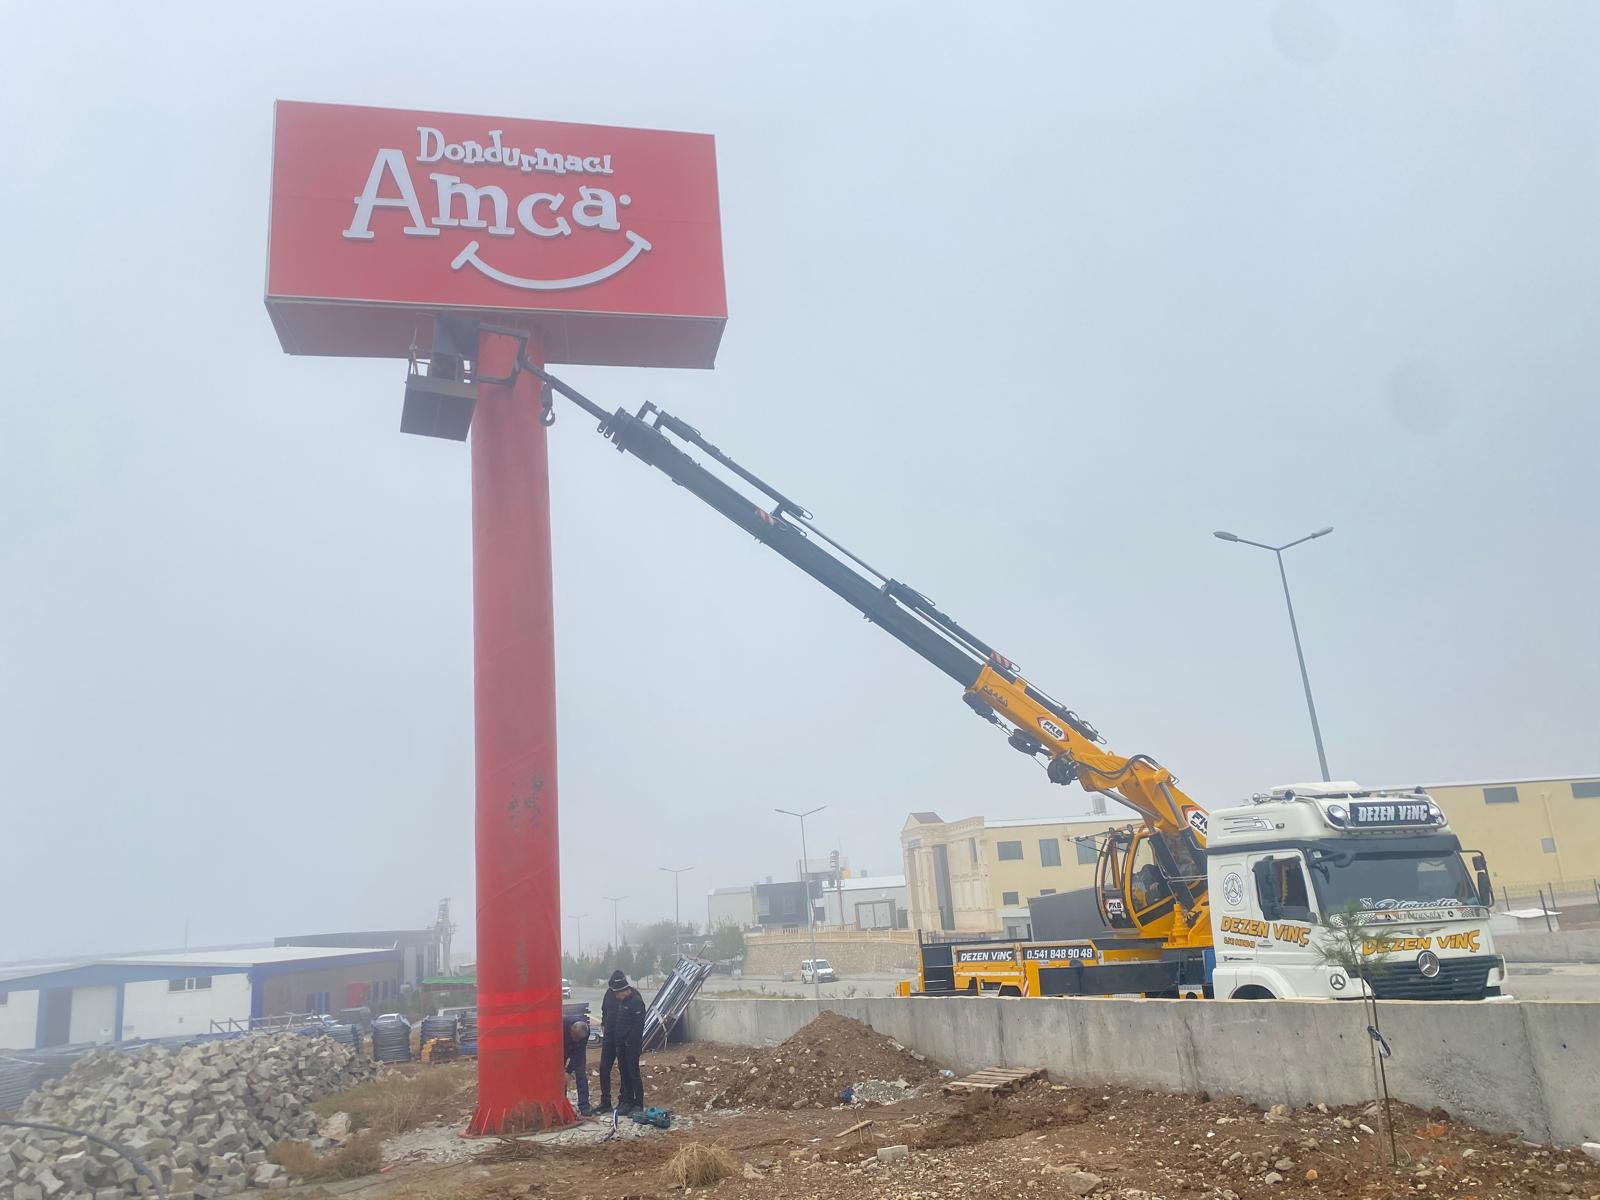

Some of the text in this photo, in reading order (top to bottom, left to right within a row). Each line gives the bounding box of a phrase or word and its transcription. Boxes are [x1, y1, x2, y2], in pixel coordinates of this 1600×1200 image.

[342, 148, 620, 238] Amca
[1357, 806, 1395, 822] DEZEN
[1220, 915, 1270, 938] DEZEN
[1026, 947, 1093, 960] 0.541 848 90 48
[1362, 936, 1432, 956] DEZEN
[960, 951, 990, 962] DEZEN
